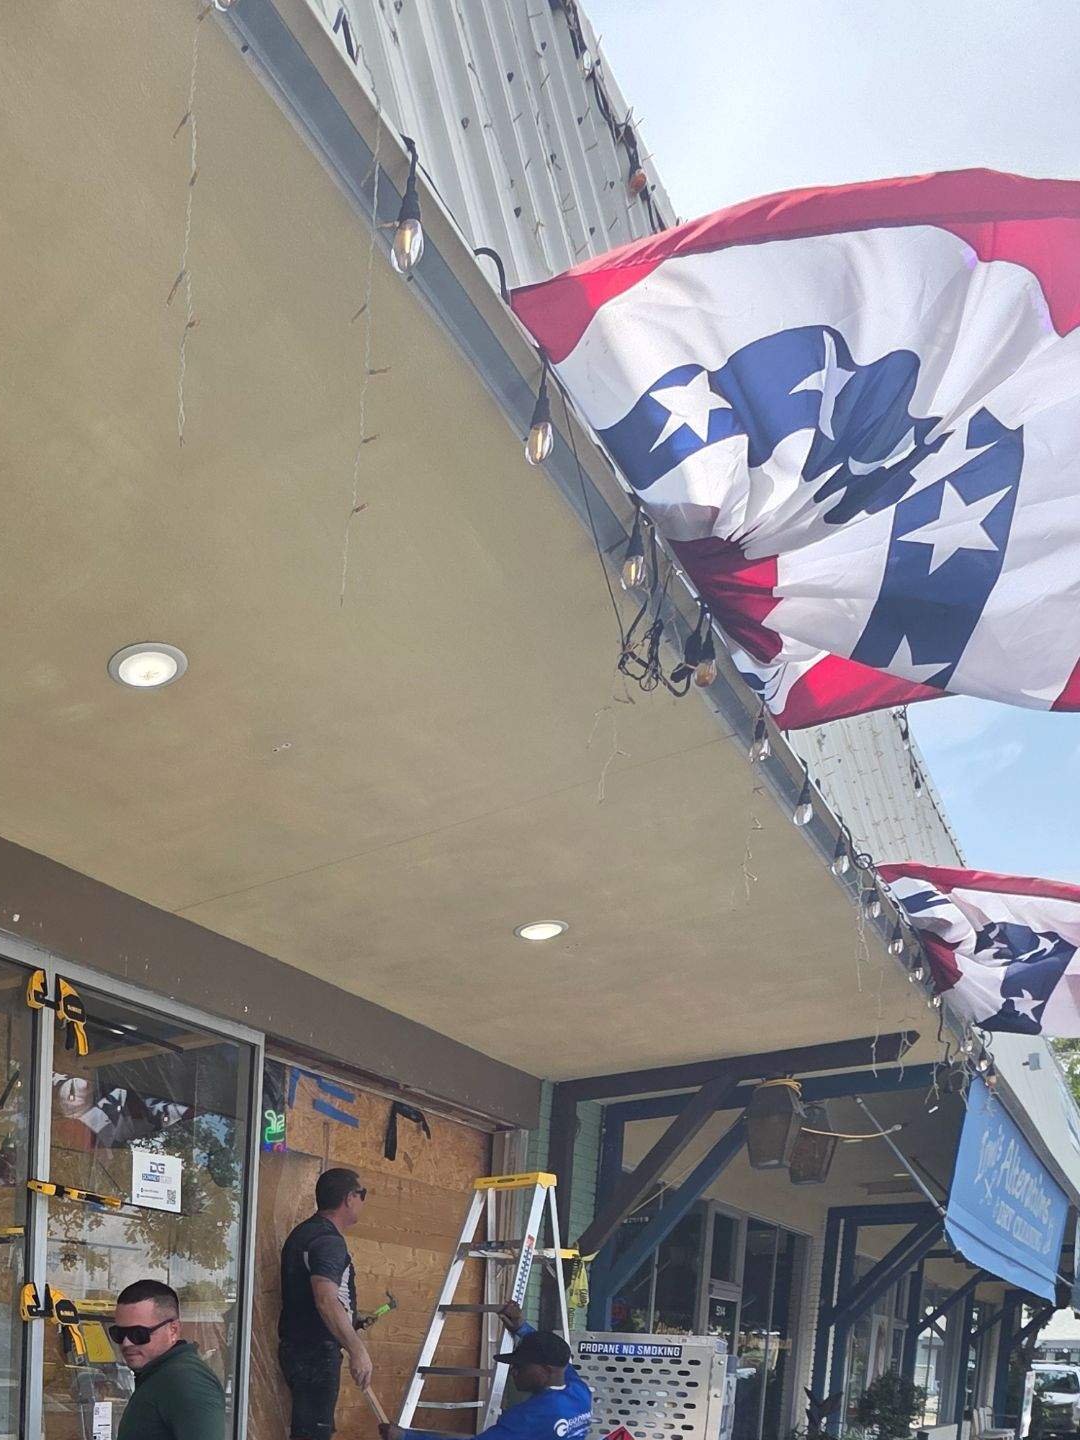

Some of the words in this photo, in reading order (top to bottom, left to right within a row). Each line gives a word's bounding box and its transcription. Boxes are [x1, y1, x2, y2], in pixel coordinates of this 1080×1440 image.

[149, 1161, 166, 1175] DG
[579, 1342, 620, 1355] PROPANE
[622, 1345, 636, 1355] NO
[636, 1345, 681, 1357] SMOKING
